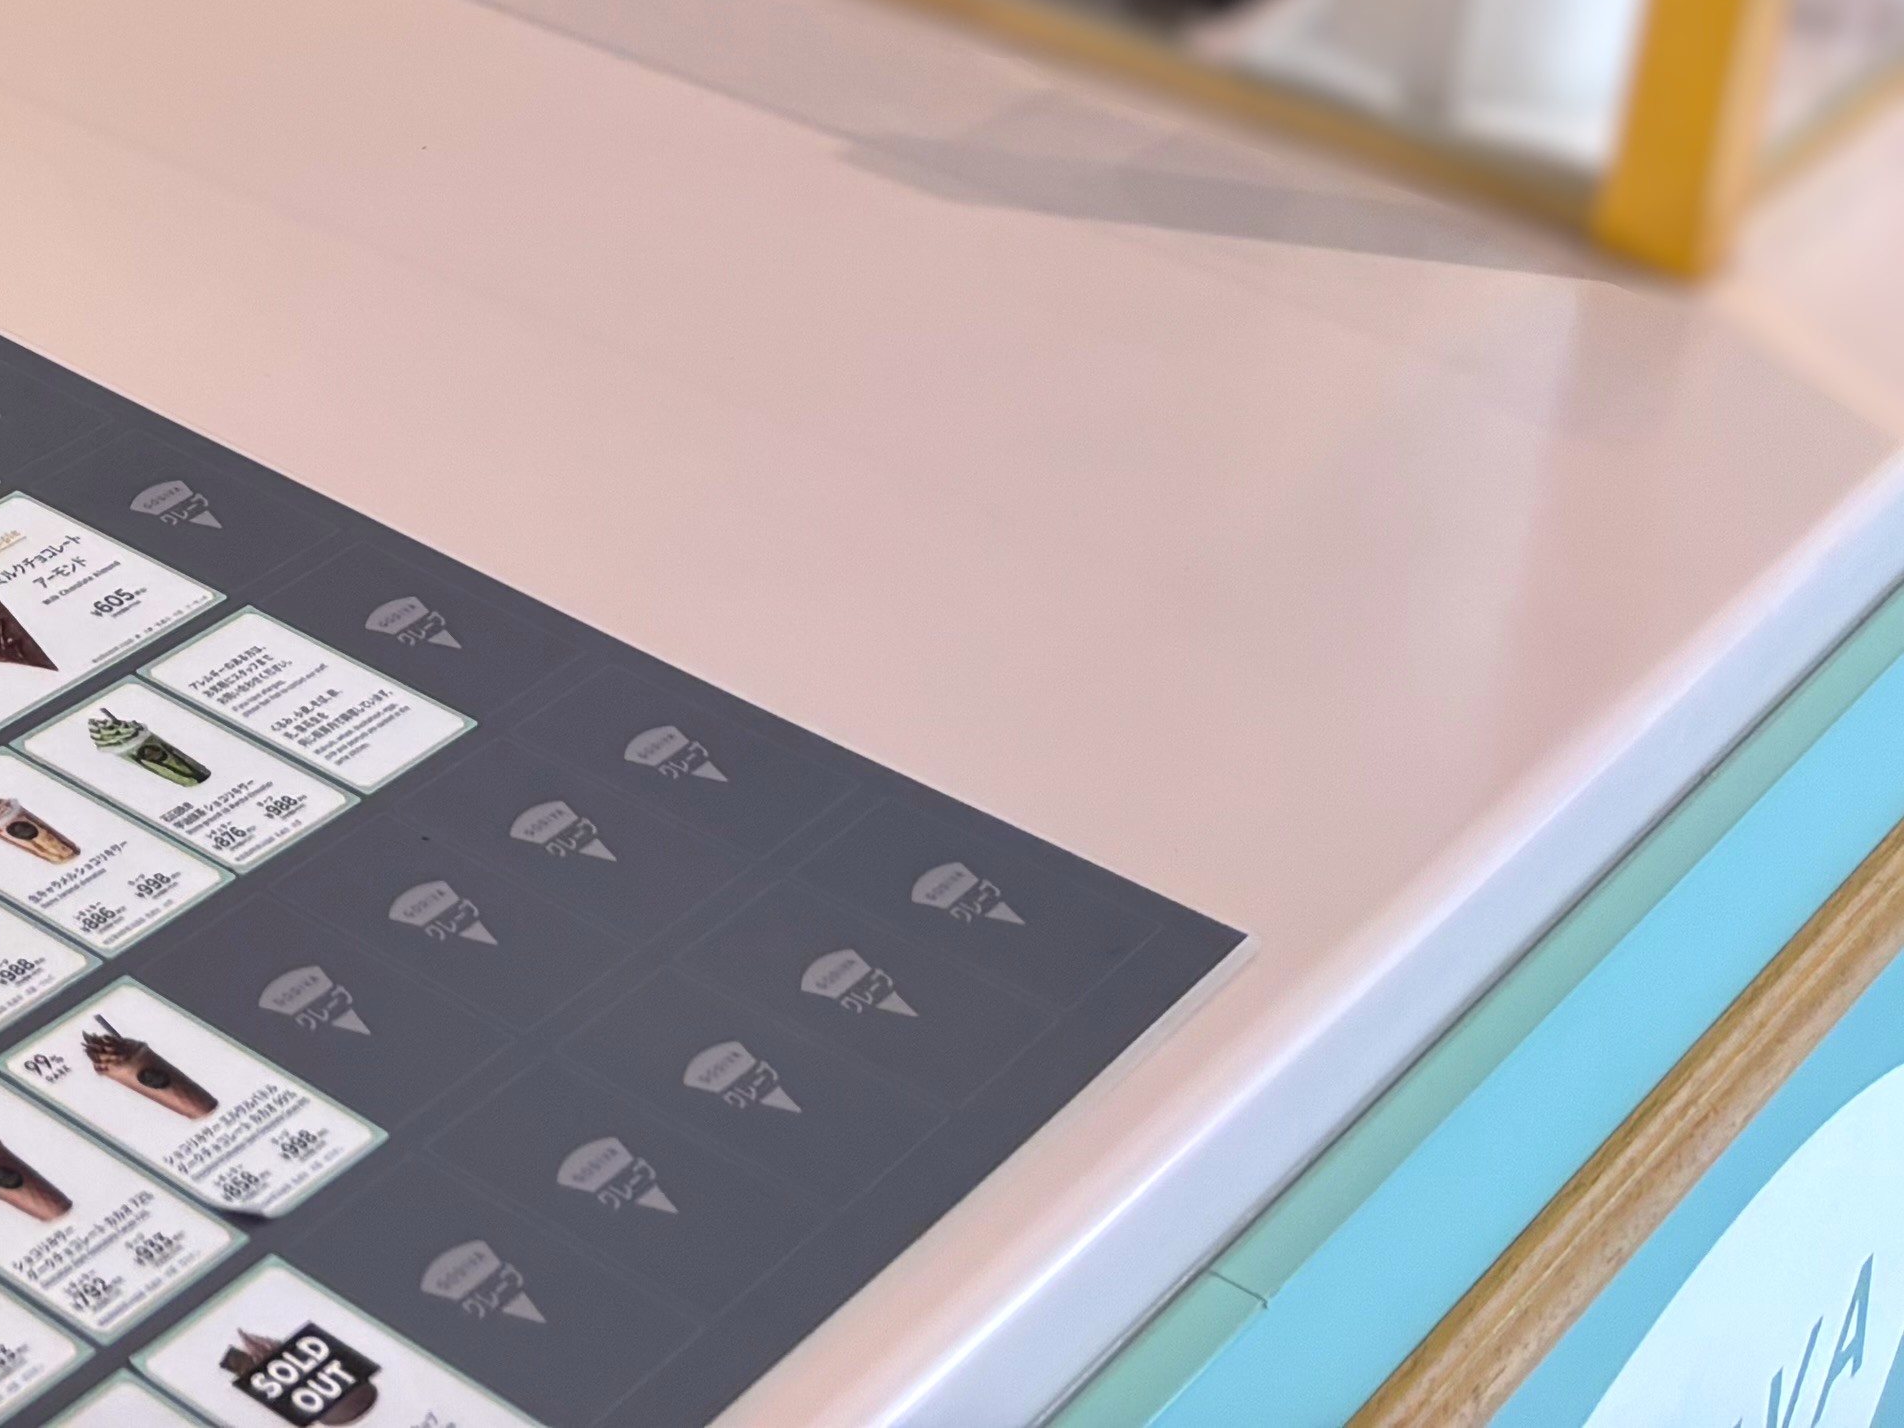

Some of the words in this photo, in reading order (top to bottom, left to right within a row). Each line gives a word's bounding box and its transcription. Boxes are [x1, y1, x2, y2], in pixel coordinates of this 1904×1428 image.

[155, 493, 208, 525] クレープ
[32, 557, 86, 588] アーモンド
[91, 588, 136, 617] ¥605
[393, 611, 446, 646] クレープ
[657, 741, 709, 779] クレープ
[213, 827, 247, 850] ¥876
[545, 817, 597, 857] クレープ
[425, 898, 479, 941] クレープ
[947, 879, 1001, 923] クレープ
[0, 959, 35, 985] ¥988
[840, 968, 893, 1013] クレープ
[295, 985, 353, 1030] クレープ
[24, 1054, 63, 1076] 99%
[722, 1060, 778, 1109] クレープ
[597, 1157, 656, 1210] クレープ
[462, 1263, 524, 1320] クレープ
[250, 1335, 330, 1399] SOLD
[292, 1361, 357, 1415] OUT
